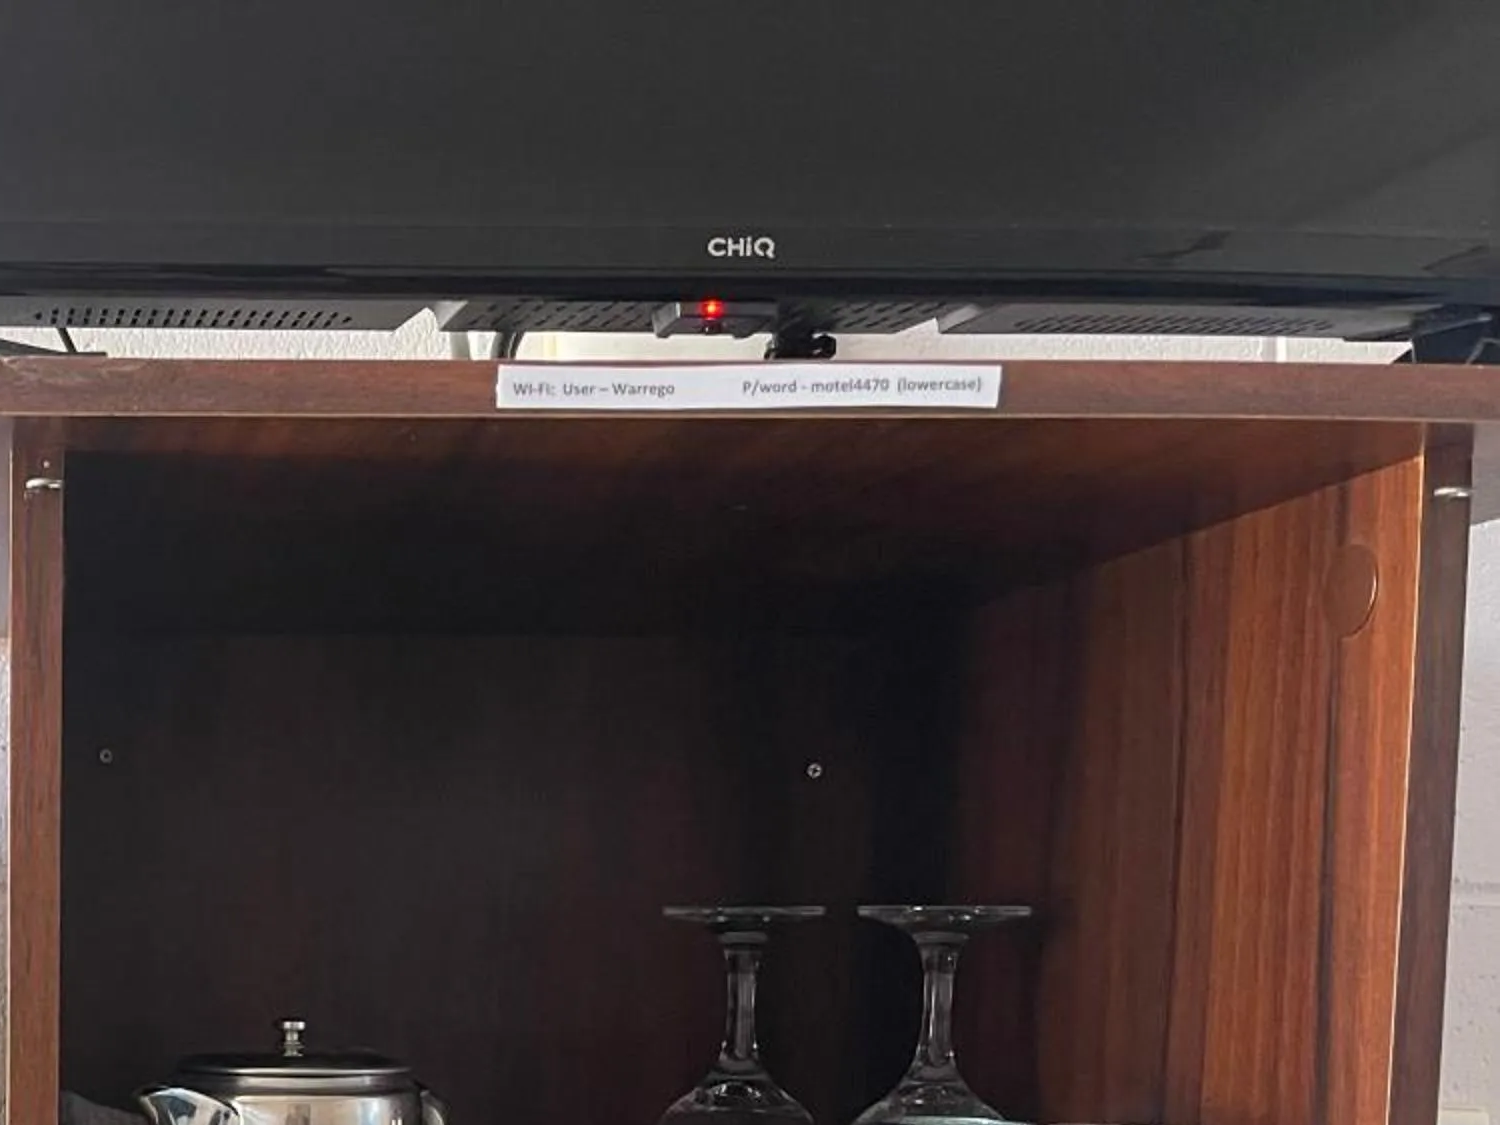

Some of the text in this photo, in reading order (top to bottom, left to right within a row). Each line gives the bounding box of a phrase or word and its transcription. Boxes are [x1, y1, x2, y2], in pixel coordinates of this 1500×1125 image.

[563, 383, 596, 397] User
[612, 382, 676, 399] Warrego
[741, 378, 798, 397] P/word
[810, 377, 890, 395] motel4470
[896, 375, 983, 394] (lowercase)
